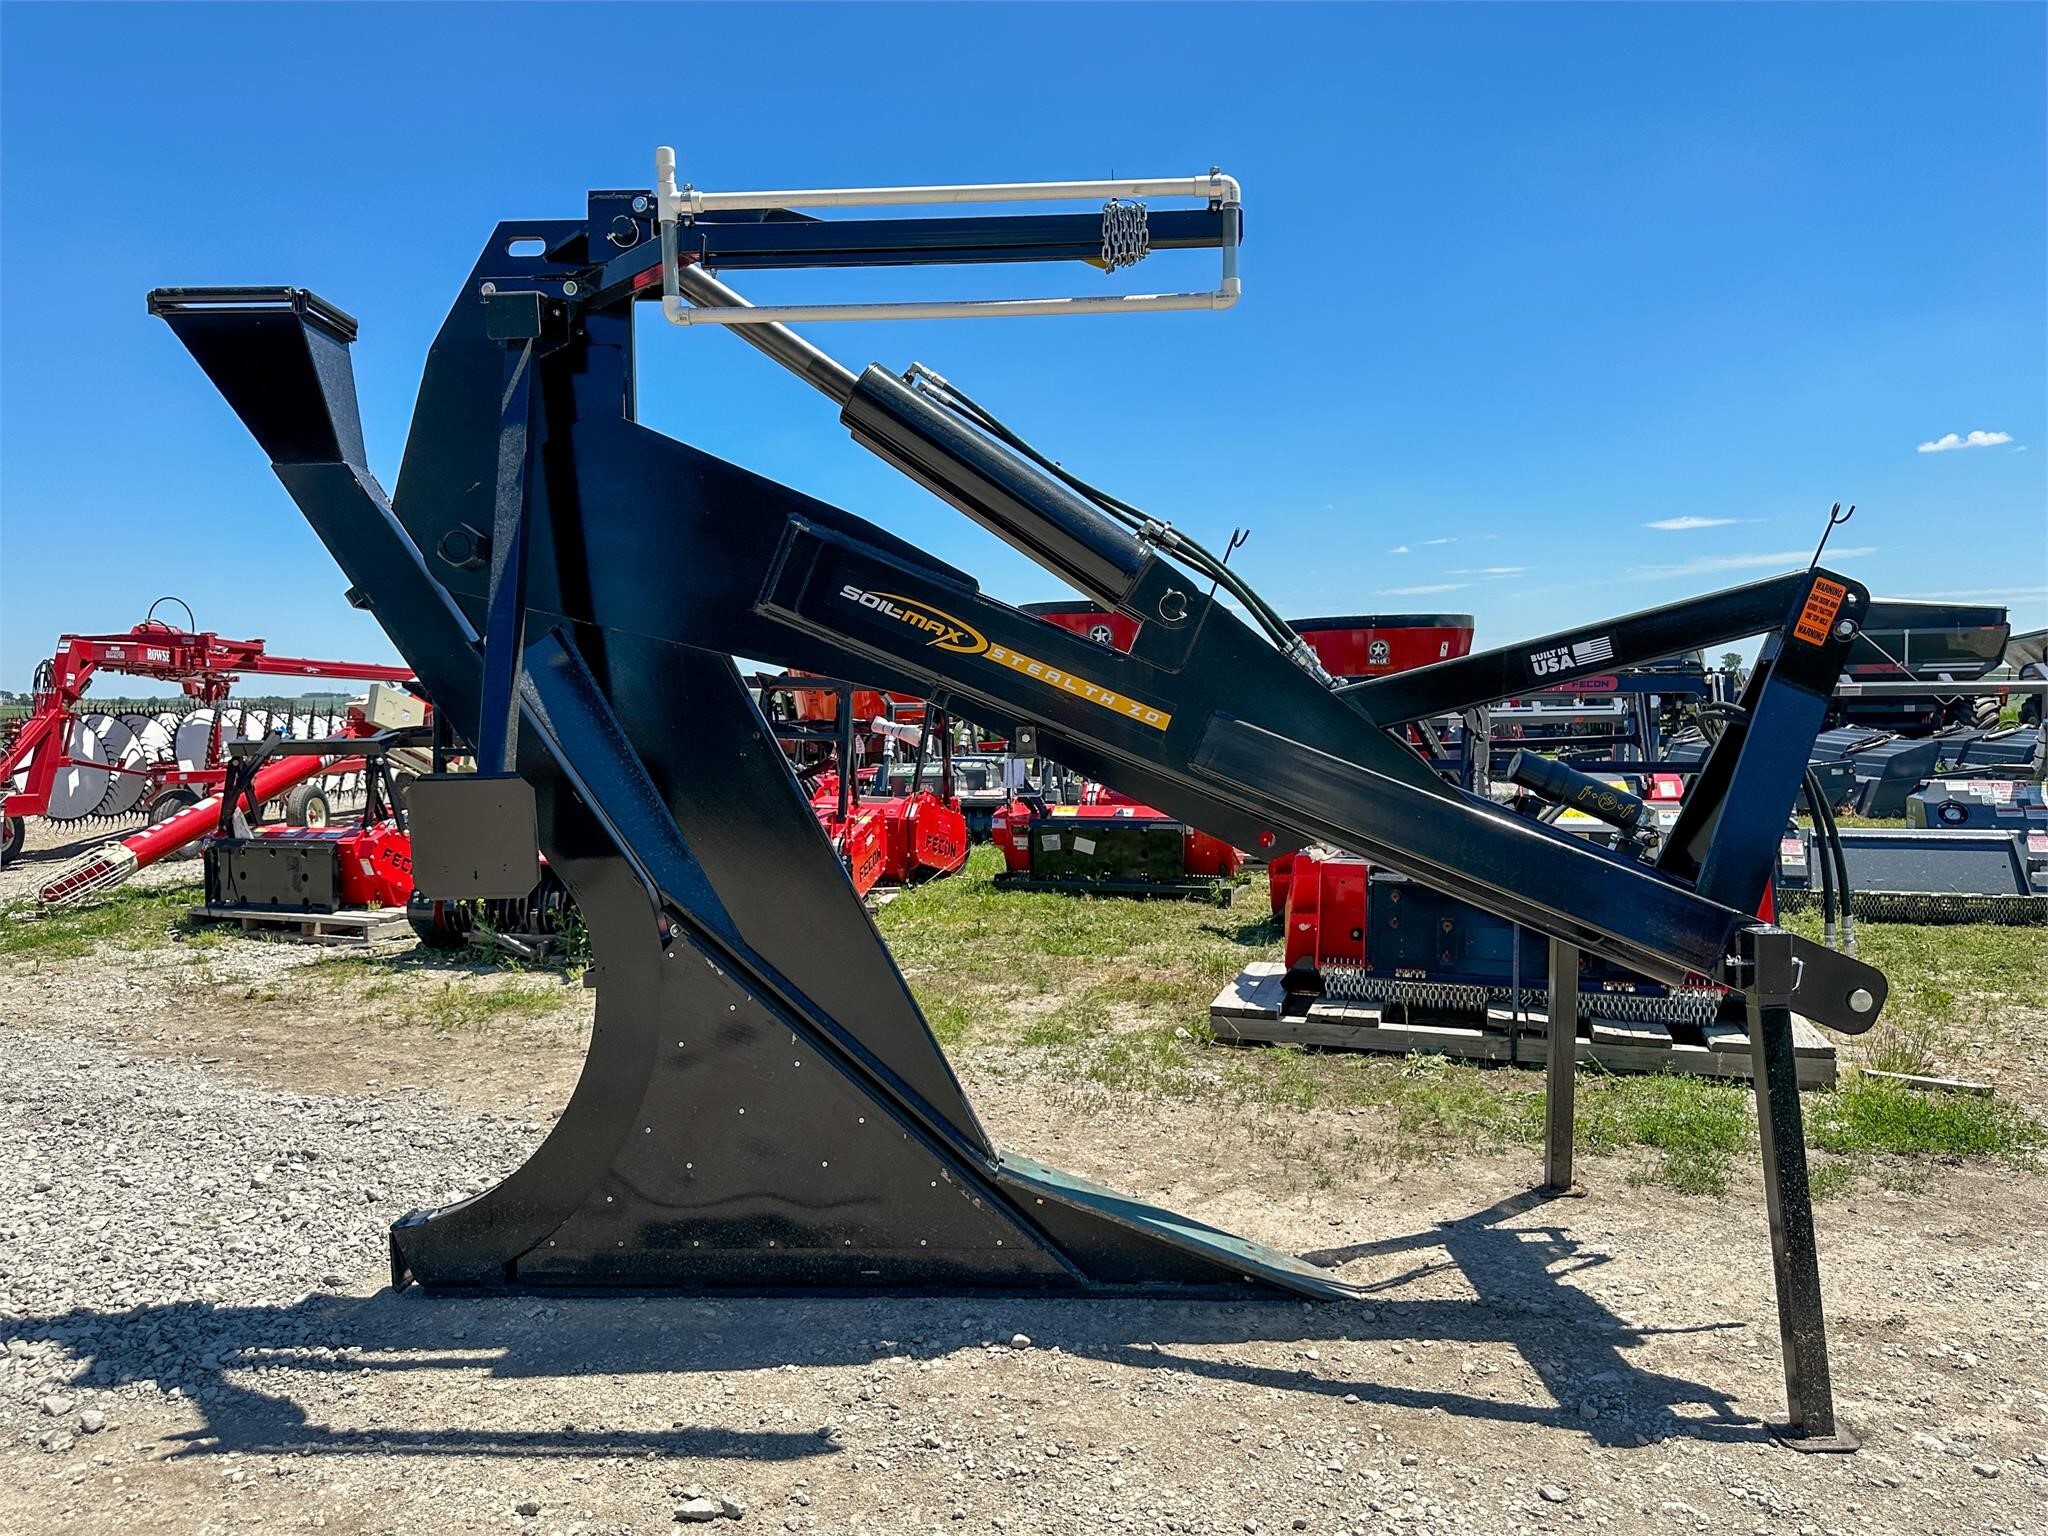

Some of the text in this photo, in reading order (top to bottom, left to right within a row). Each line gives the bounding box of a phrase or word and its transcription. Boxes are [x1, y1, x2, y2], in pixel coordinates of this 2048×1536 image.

[1816, 580, 1843, 598] WARNING
[840, 585, 965, 646] SOIL-MAX
[1798, 624, 1824, 641] WARNING
[147, 648, 170, 662] ROWSE
[1530, 646, 1569, 662] BUILT IN
[1532, 654, 1575, 676] USA
[991, 648, 1116, 705] STEALTH
[1571, 680, 1609, 688] FECON
[926, 834, 957, 858] FECON
[382, 847, 412, 874] FEC
[860, 849, 881, 883] FECON
